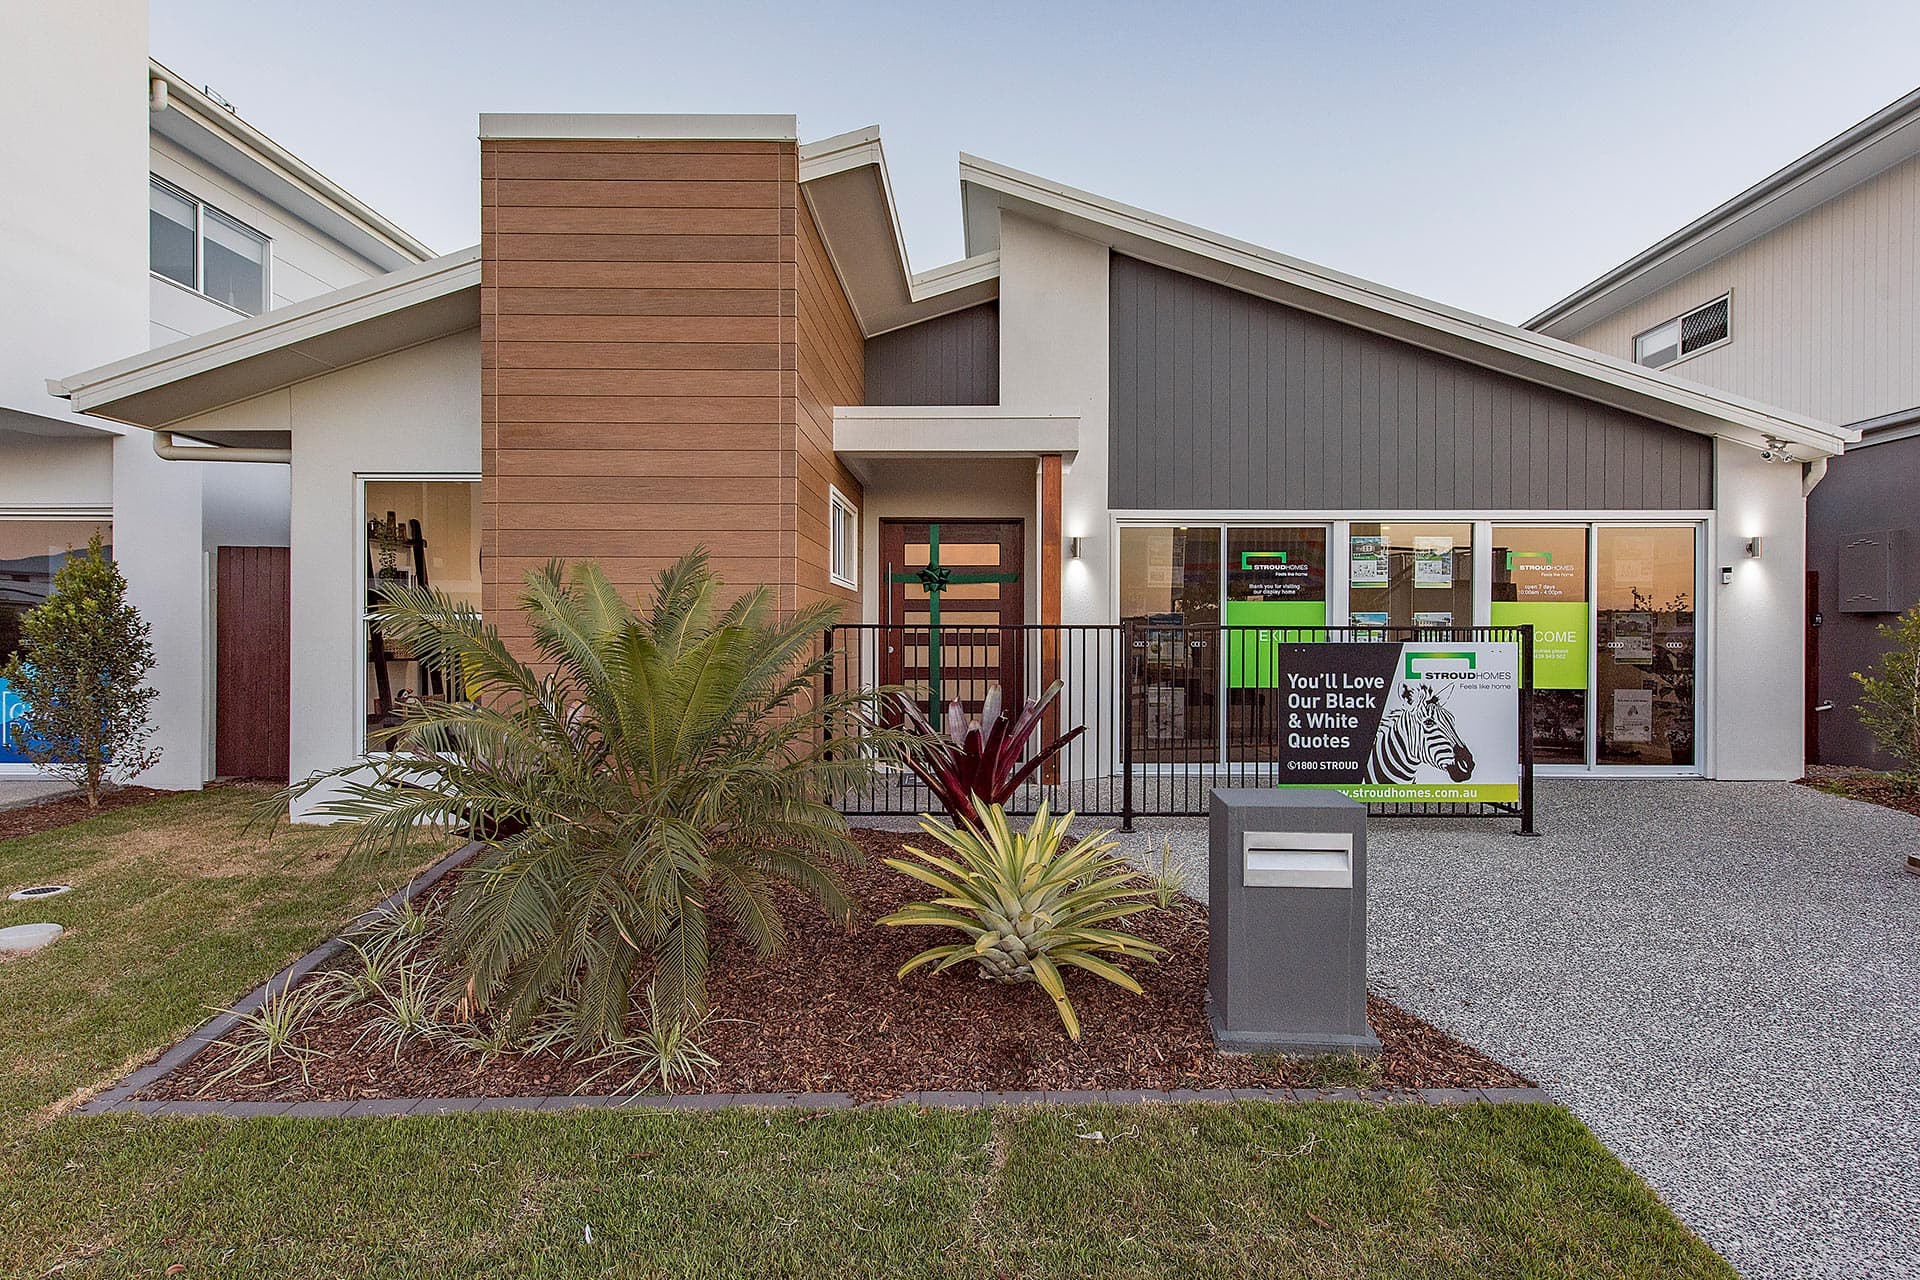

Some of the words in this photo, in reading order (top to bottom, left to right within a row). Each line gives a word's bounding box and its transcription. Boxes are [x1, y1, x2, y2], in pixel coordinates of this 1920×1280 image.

[1287, 673, 1338, 689] You'll
[1343, 673, 1385, 689] Love
[1425, 671, 1512, 680] STROUDHOMES
[1288, 693, 1321, 709] Our
[1326, 693, 1376, 709] Black
[1288, 713, 1302, 729] &
[1306, 713, 1359, 729] White
[1288, 732, 1351, 749] Quotes
[1319, 761, 1359, 770] STROUD
